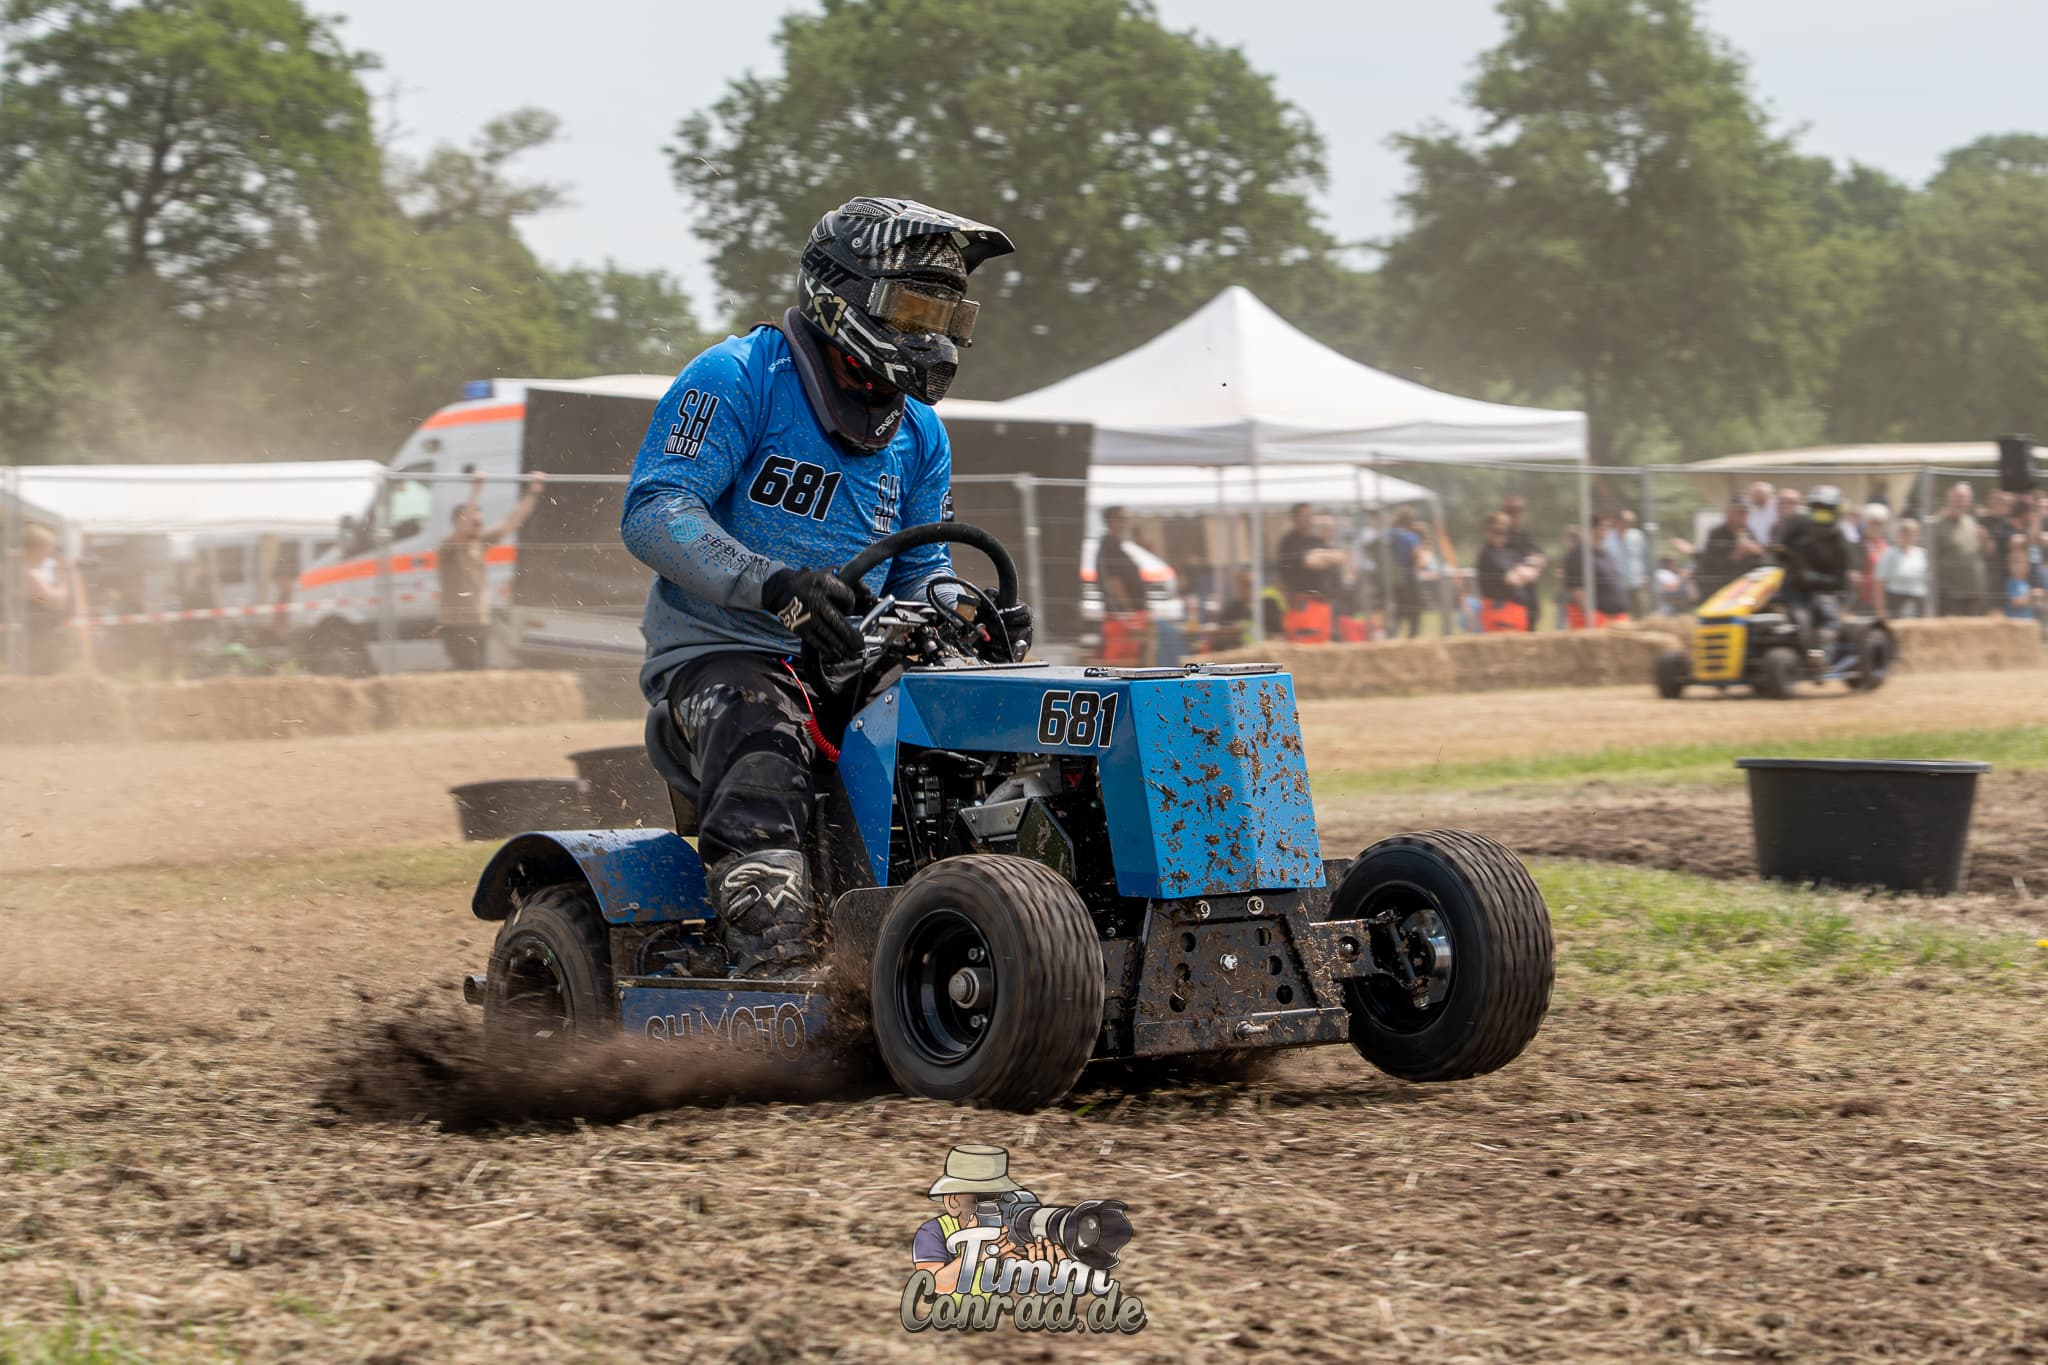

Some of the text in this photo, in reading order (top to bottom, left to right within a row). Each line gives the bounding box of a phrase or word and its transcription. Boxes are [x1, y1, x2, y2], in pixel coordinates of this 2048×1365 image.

[671, 388, 720, 440] SH
[666, 435, 699, 456] MOTO
[748, 454, 843, 521] 681
[1037, 689, 1119, 748] 681
[700, 1002, 806, 1062] MOTO
